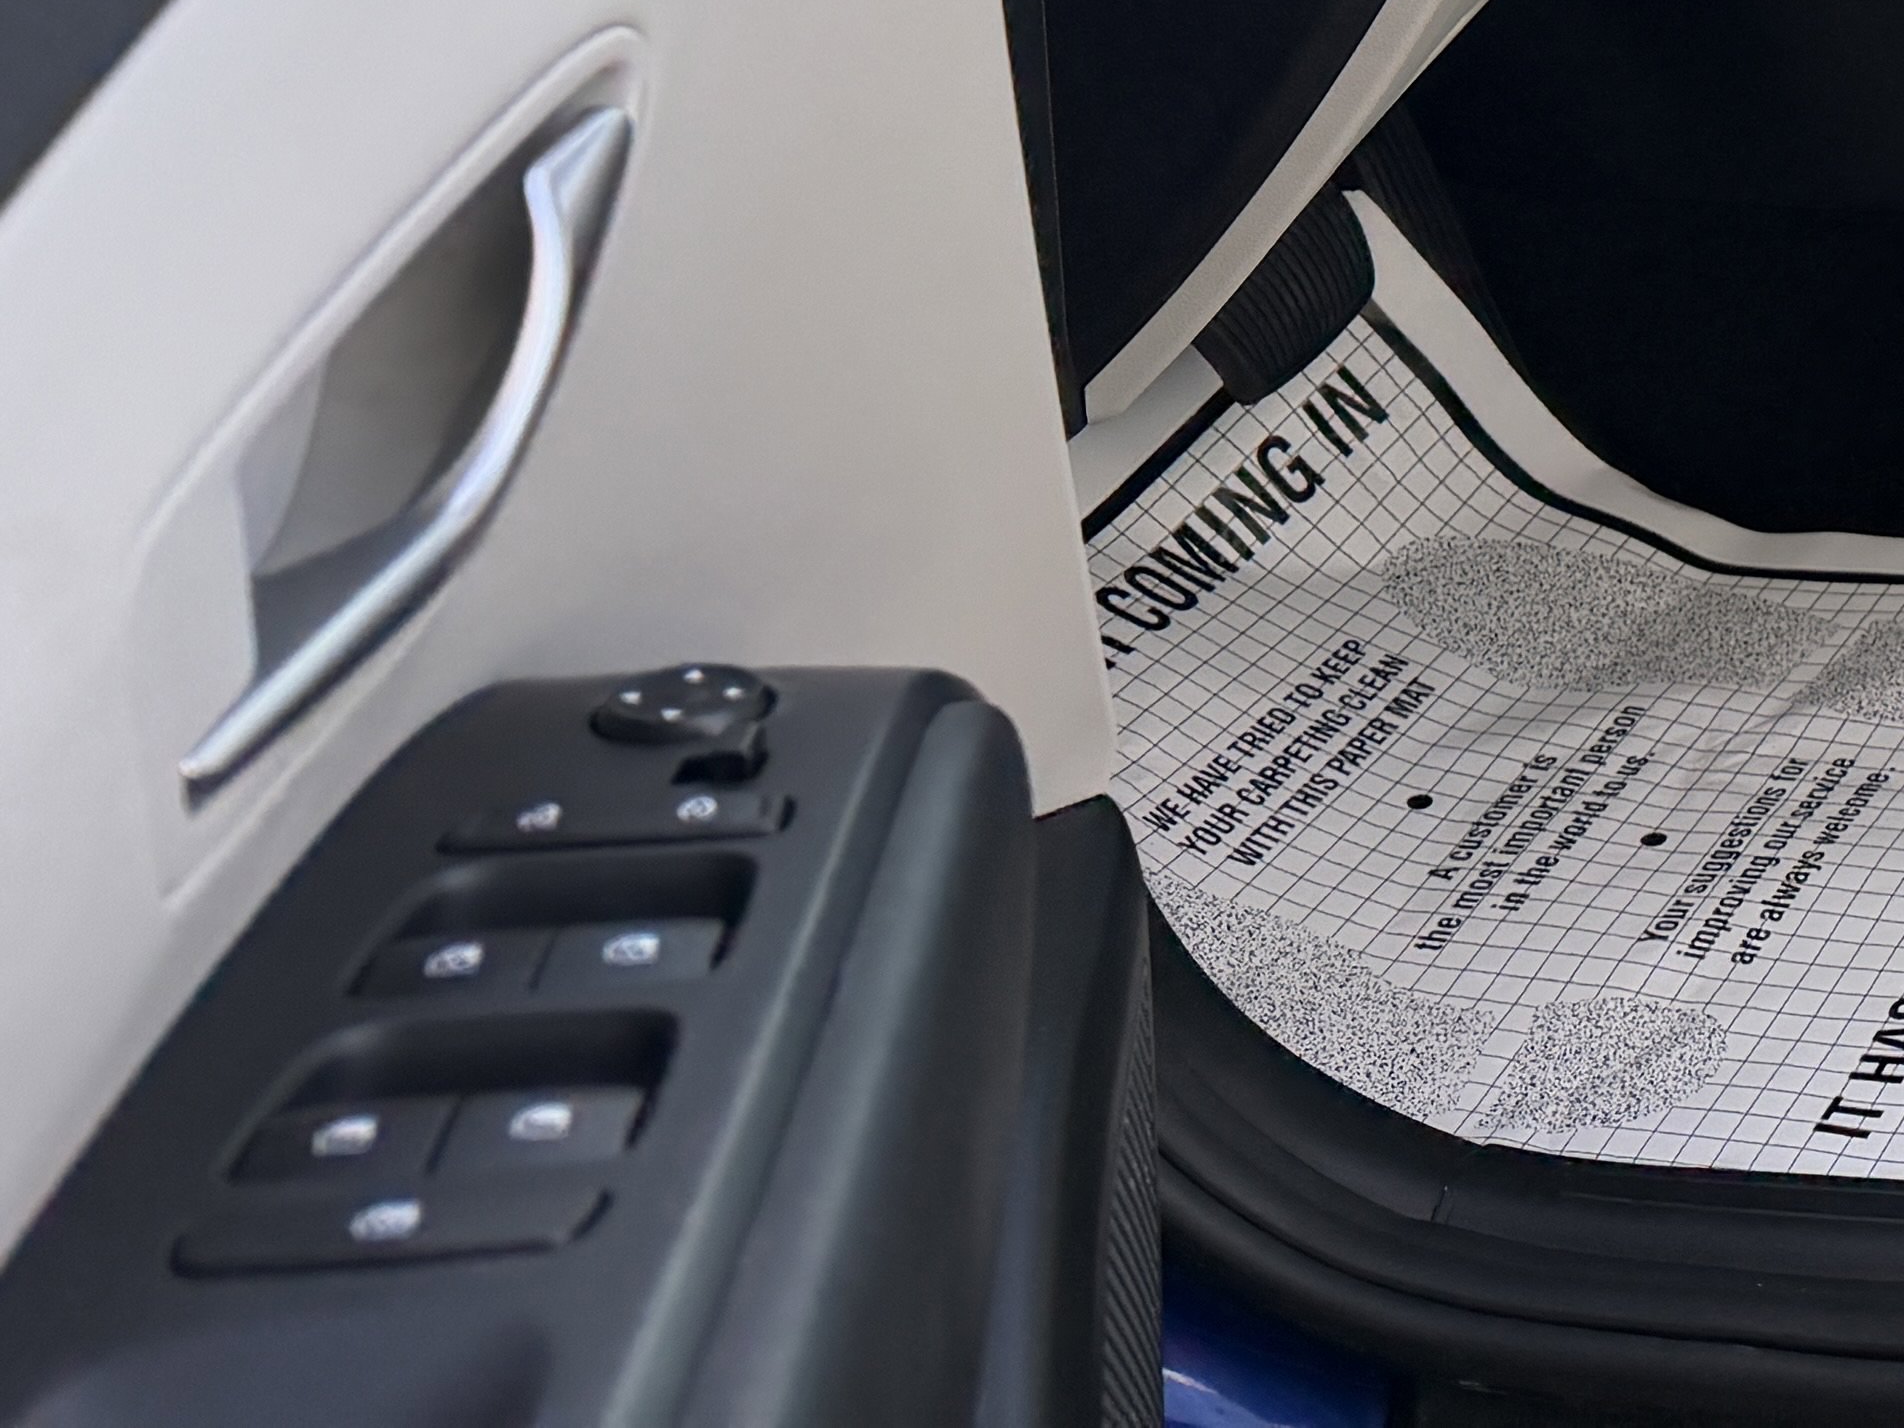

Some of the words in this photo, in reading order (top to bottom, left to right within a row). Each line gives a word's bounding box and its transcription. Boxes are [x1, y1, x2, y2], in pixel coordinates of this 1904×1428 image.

[1095, 435, 1326, 631] COMING
[1302, 363, 1390, 458] IN
[1142, 797, 1192, 832] WE
[1177, 753, 1242, 805] HAVE
[1227, 707, 1296, 758] TRIED
[1284, 683, 1324, 708] TO
[1311, 639, 1370, 685] KEEP
[1178, 802, 1250, 856] YOUR
[1236, 708, 1351, 806] CARPETING
[1339, 653, 1410, 712] CLEAN
[1227, 815, 1296, 867] WITH
[1280, 772, 1340, 817] THIS
[1326, 716, 1400, 777] PAPER
[1384, 676, 1436, 720] MAT
[1414, 917, 1462, 952] the
[1453, 860, 1510, 910] most
[1492, 766, 1592, 856] important
[1580, 705, 1646, 767] person
[1427, 865, 1459, 882] A
[1449, 774, 1538, 862] customer
[1523, 754, 1557, 773] is
[1491, 891, 1530, 912] in
[1514, 855, 1560, 886] the
[1550, 800, 1608, 851] world
[1592, 780, 1628, 798] to
[1617, 752, 1655, 778] us.
[1638, 899, 1695, 943] Your
[1684, 787, 1787, 894] suggestions
[1771, 757, 1809, 783] for
[1677, 855, 1781, 960] improving
[1763, 821, 1800, 852] our
[1790, 757, 1855, 821] service
[1731, 927, 1772, 965] are
[1760, 850, 1825, 922] always
[1813, 767, 1896, 846] welcome.
[1812, 1095, 1885, 1140] IT
